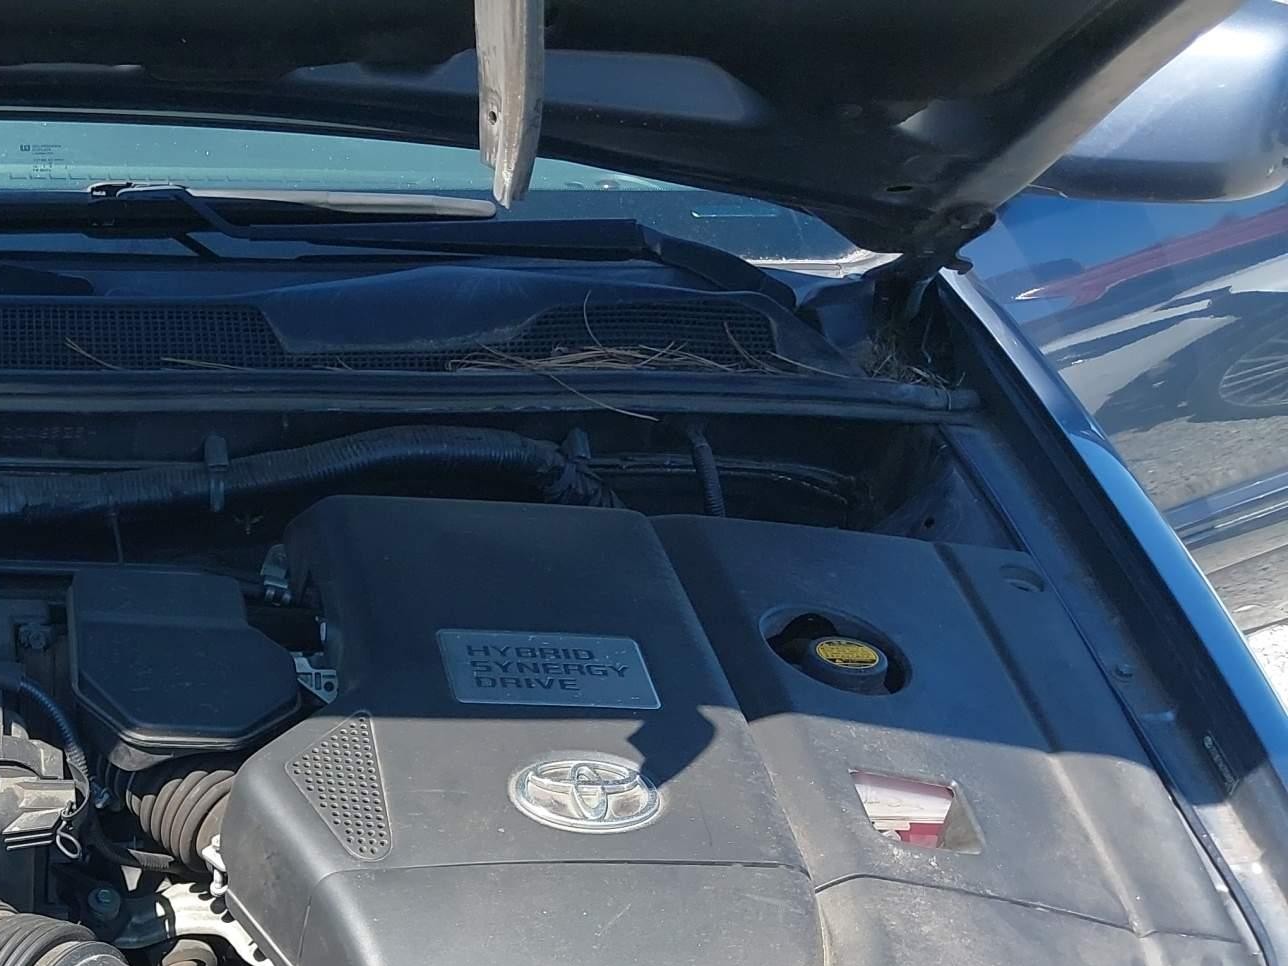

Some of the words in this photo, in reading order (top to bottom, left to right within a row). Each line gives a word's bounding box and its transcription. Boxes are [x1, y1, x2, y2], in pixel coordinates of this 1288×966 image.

[466, 644, 594, 662] HYBRID
[469, 660, 630, 679] SYNERGY
[474, 676, 581, 692] DRIVE
